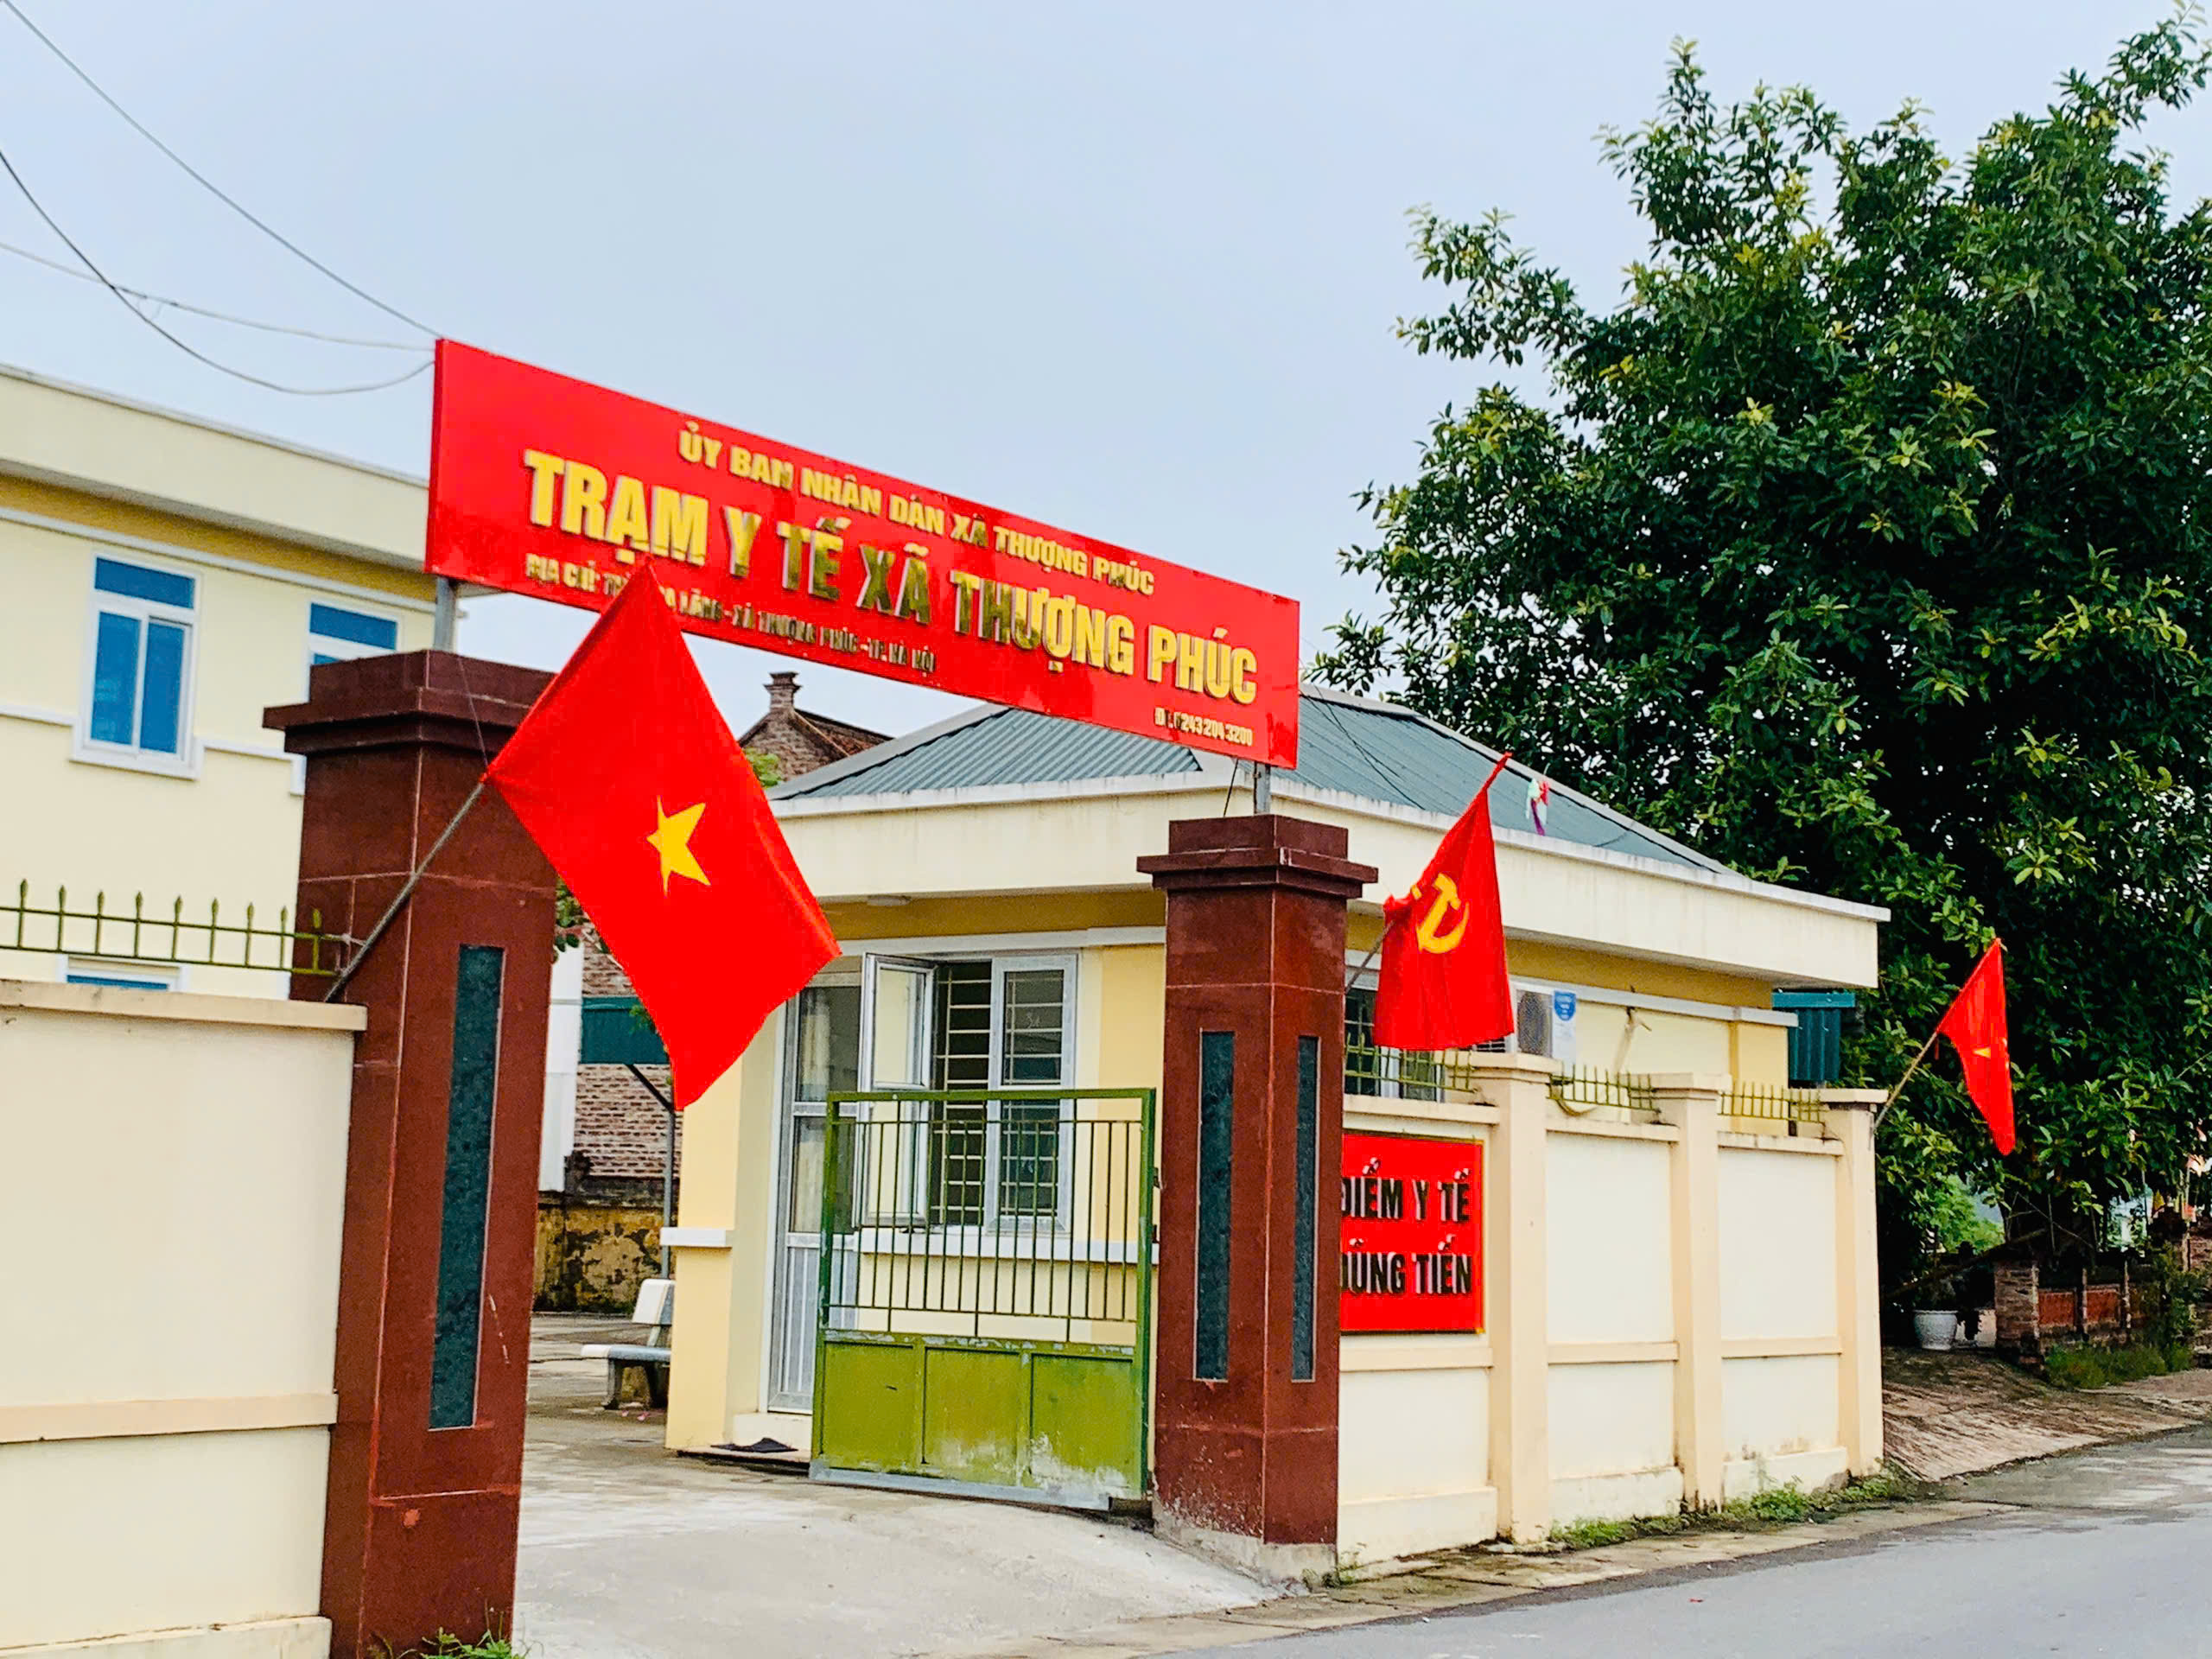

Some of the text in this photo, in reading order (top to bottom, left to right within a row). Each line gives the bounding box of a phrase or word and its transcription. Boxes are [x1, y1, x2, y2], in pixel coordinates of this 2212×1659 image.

[678, 421, 1154, 595] ỦY BAN NHÂN DÂN XÃ THƯỢNG PHÚC
[524, 448, 1258, 705] TRẠM Y TẾ XÃ THƯỢNG PHÚC
[1412, 1179, 1430, 1221] Y
[1437, 1167, 1471, 1223] TẾ
[1411, 1233, 1473, 1295] TIẾN
